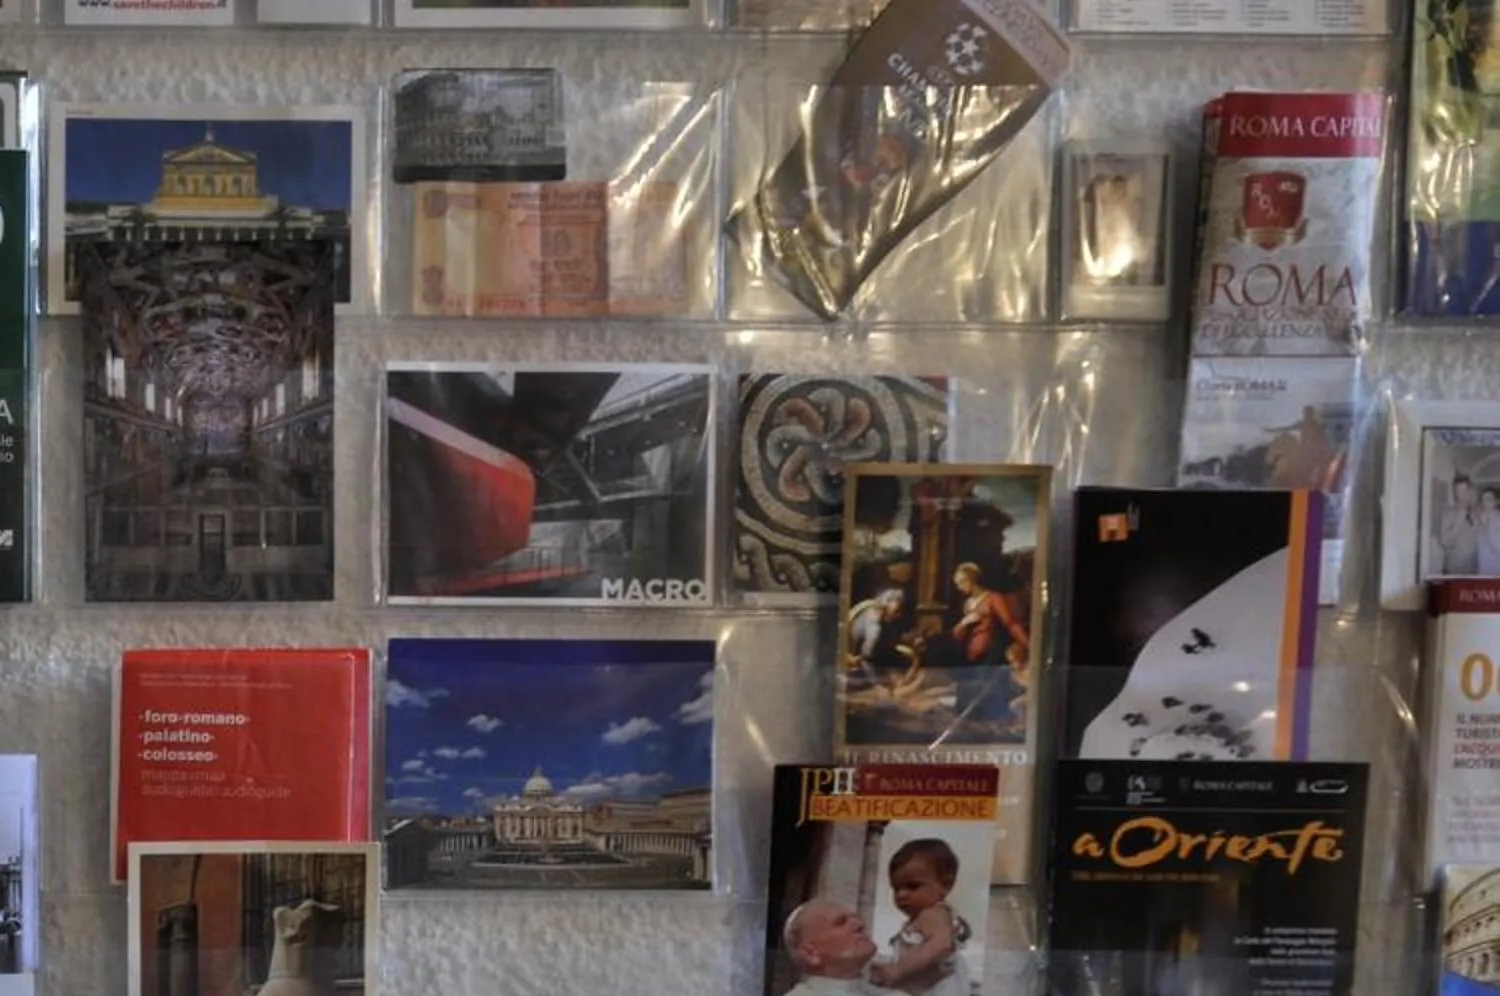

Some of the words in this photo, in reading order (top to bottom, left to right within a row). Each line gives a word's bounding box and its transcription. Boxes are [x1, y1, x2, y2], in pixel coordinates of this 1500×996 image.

[1229, 115, 1304, 137] ROMA
[1207, 263, 1358, 306] ROMA
[600, 578, 704, 601] MACRO
[810, 799, 990, 818] BEATIFICAZIONE
[1109, 814, 1345, 876] Oriente
